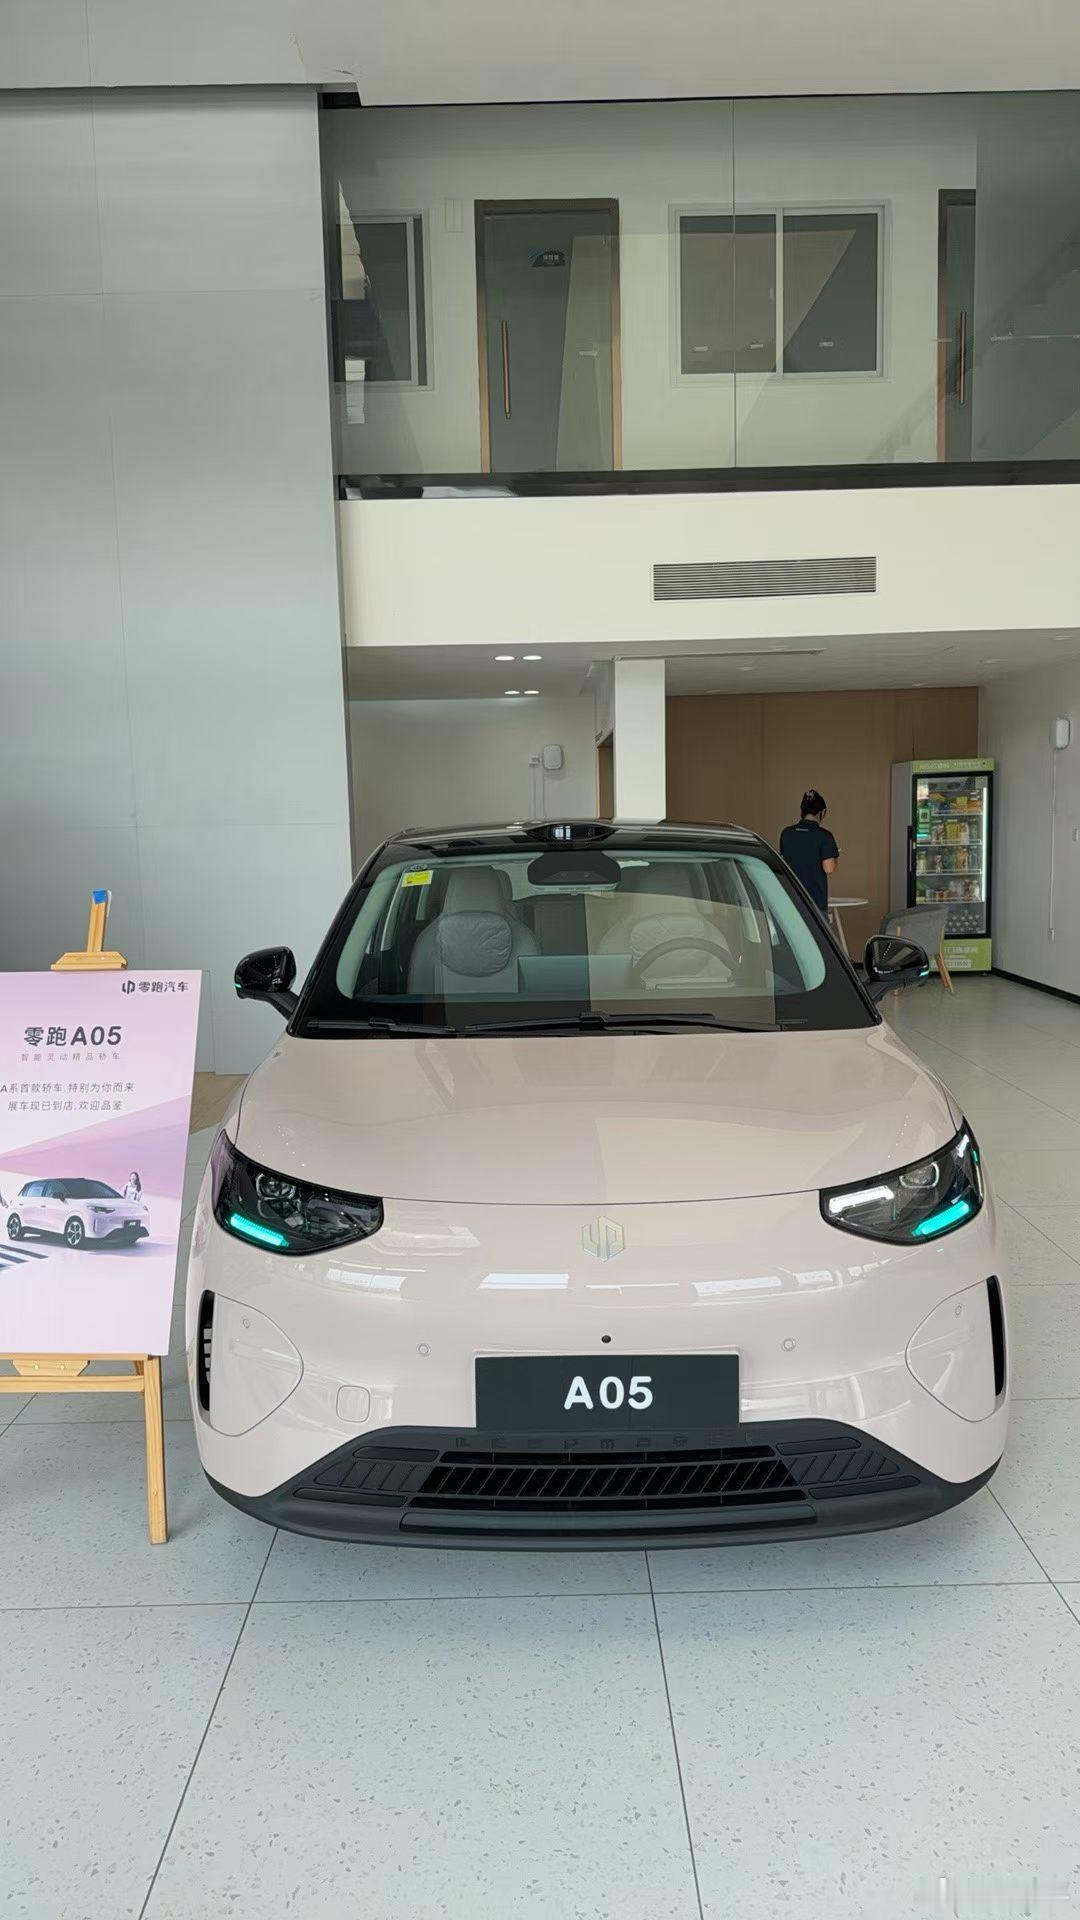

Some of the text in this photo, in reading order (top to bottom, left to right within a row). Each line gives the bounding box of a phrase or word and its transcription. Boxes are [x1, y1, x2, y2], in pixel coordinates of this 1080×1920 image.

[138, 981, 189, 993] 零跑汽车
[24, 1025, 122, 1047] 零跑A05
[563, 1375, 654, 1411] A05
